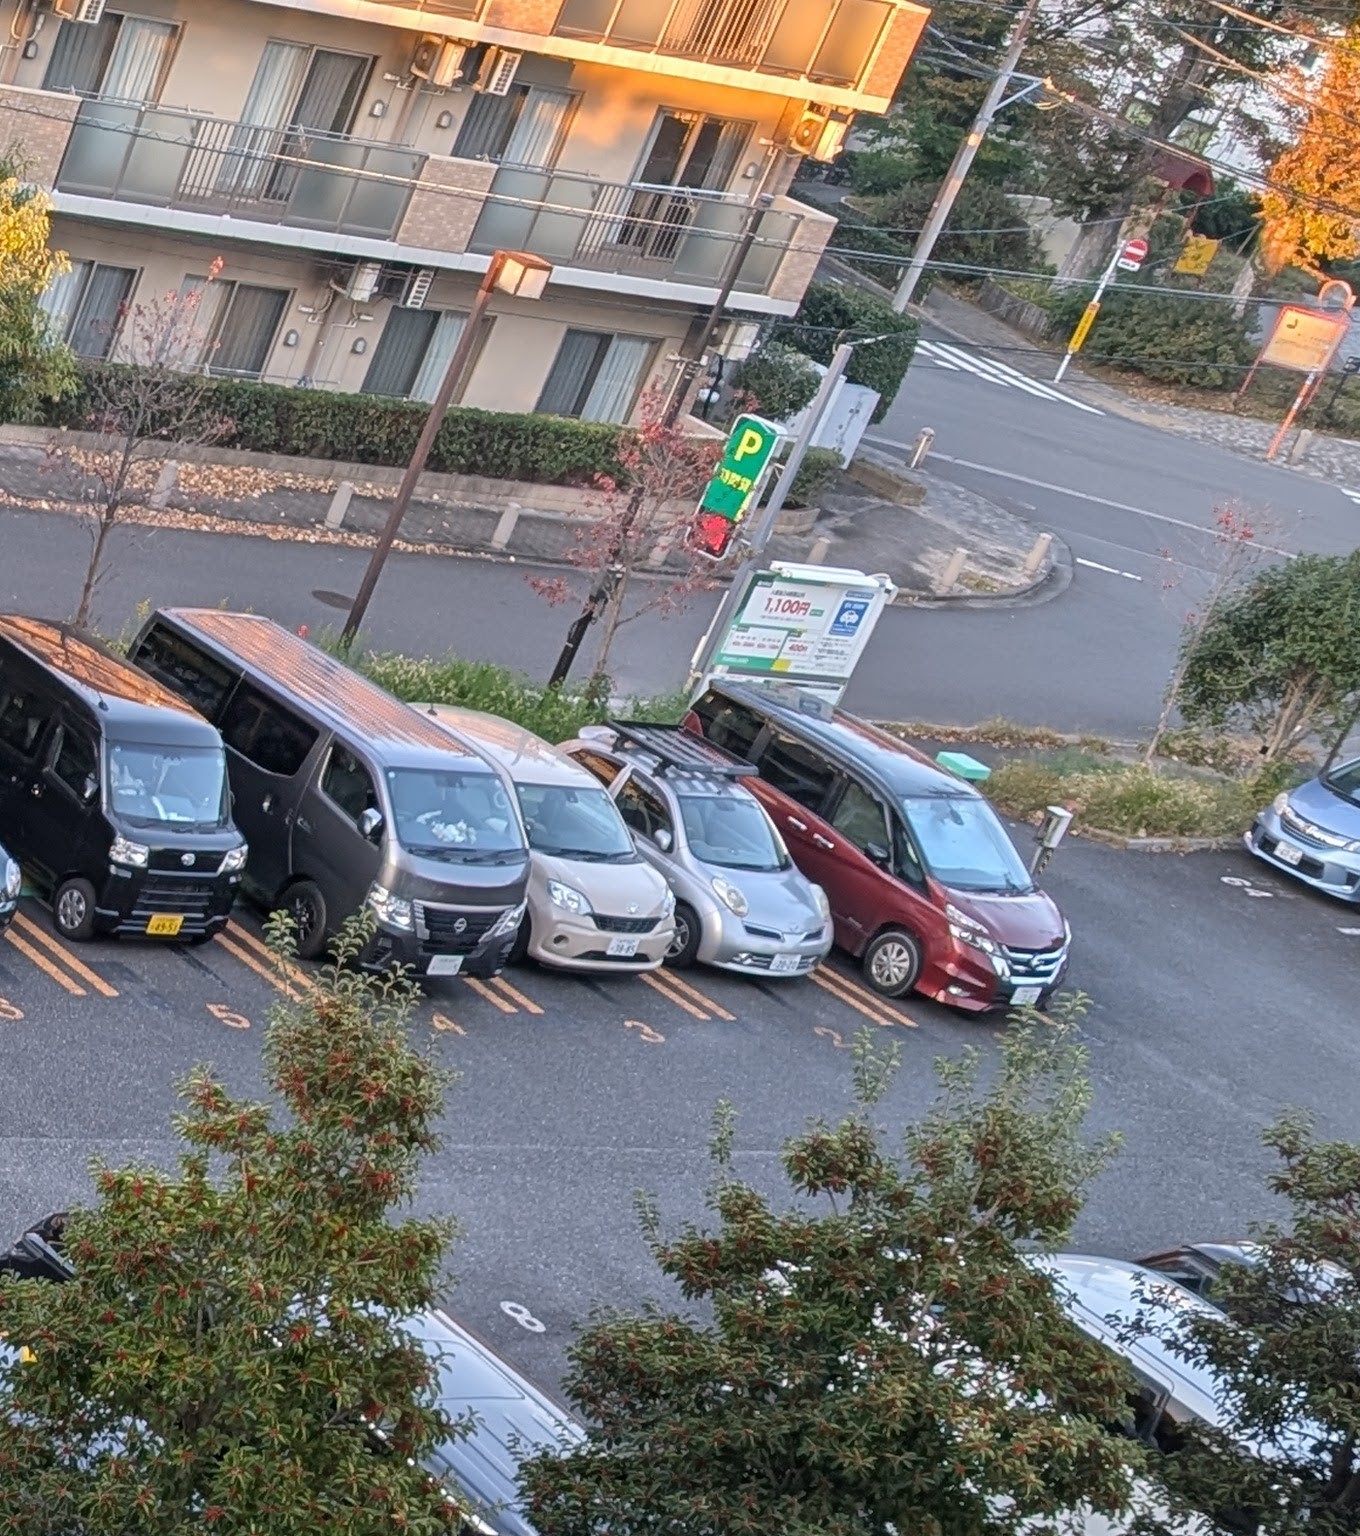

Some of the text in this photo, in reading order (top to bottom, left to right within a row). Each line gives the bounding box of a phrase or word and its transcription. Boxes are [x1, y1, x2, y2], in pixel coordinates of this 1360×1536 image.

[734, 428, 763, 461] P
[764, 597, 812, 616] 1,100円
[206, 1003, 251, 1029] 5
[624, 1020, 666, 1043] 3
[500, 1301, 547, 1333] 8
